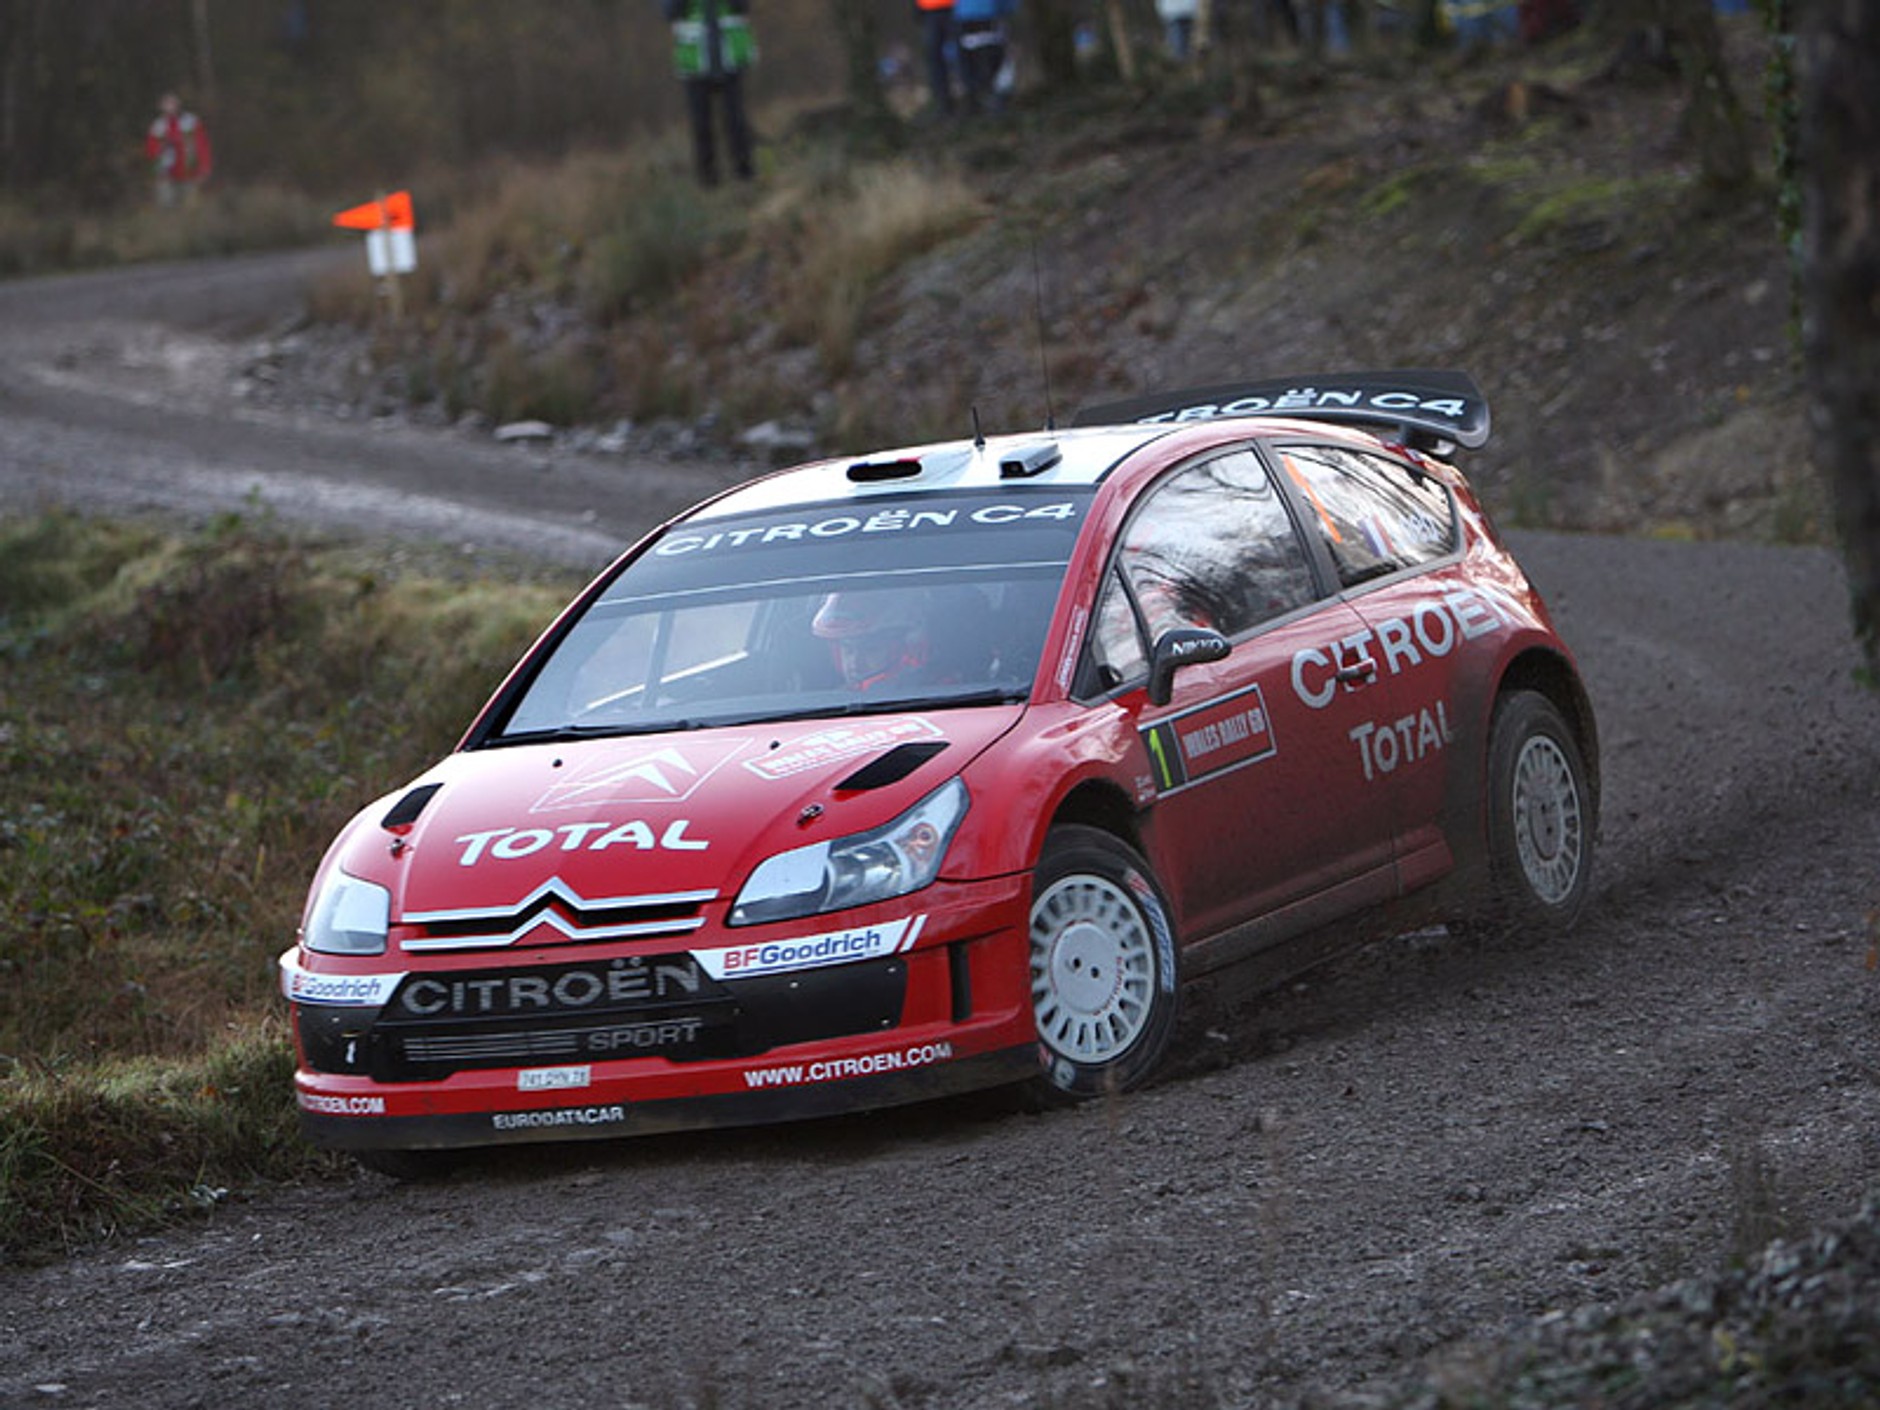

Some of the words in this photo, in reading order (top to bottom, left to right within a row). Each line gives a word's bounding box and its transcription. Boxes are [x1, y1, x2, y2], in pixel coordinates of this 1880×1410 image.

[1370, 392, 1465, 416] C4
[655, 509, 957, 556] CITROËN
[970, 502, 1076, 523] C4
[1149, 728, 1173, 789] 1
[455, 820, 709, 866] TOTAL
[723, 930, 881, 969] BFGoodrich
[401, 956, 699, 1014] CITROËN
[588, 1022, 700, 1051] SPORT
[744, 1042, 953, 1088] WWW.CITROEN.COM
